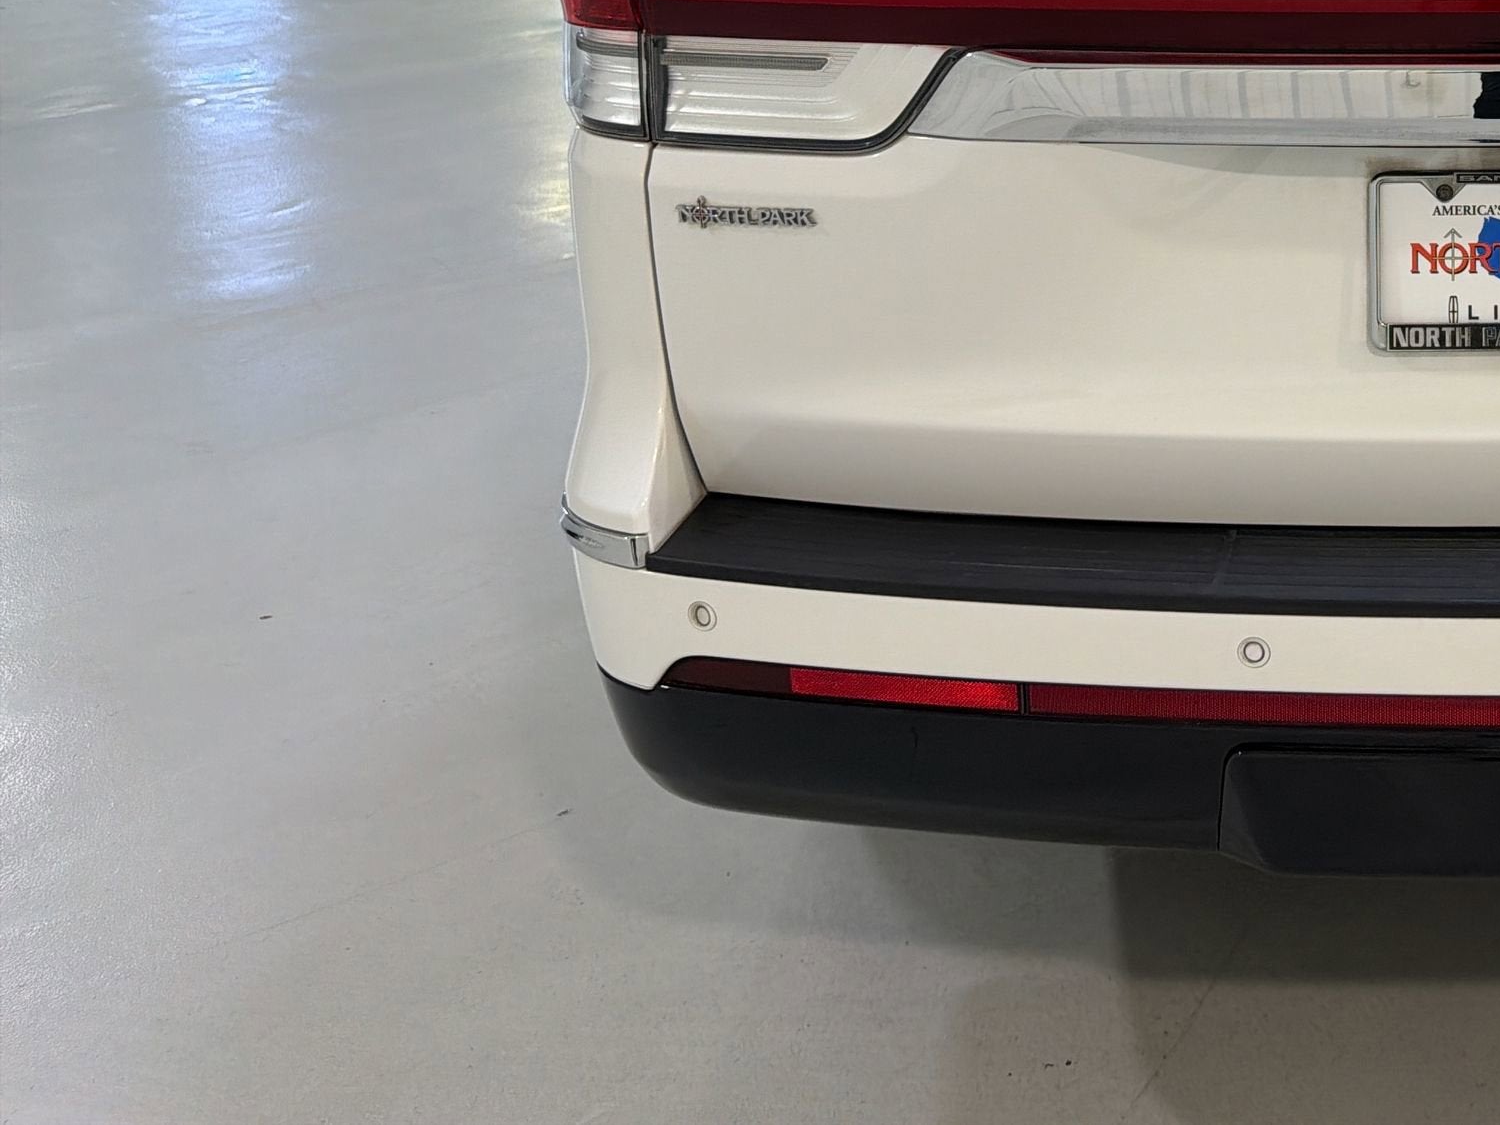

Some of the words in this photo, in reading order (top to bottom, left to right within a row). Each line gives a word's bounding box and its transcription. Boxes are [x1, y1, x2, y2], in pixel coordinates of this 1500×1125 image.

[676, 205, 756, 226] NORTH
[757, 207, 817, 226] PARK
[1392, 327, 1472, 348] NORTH
